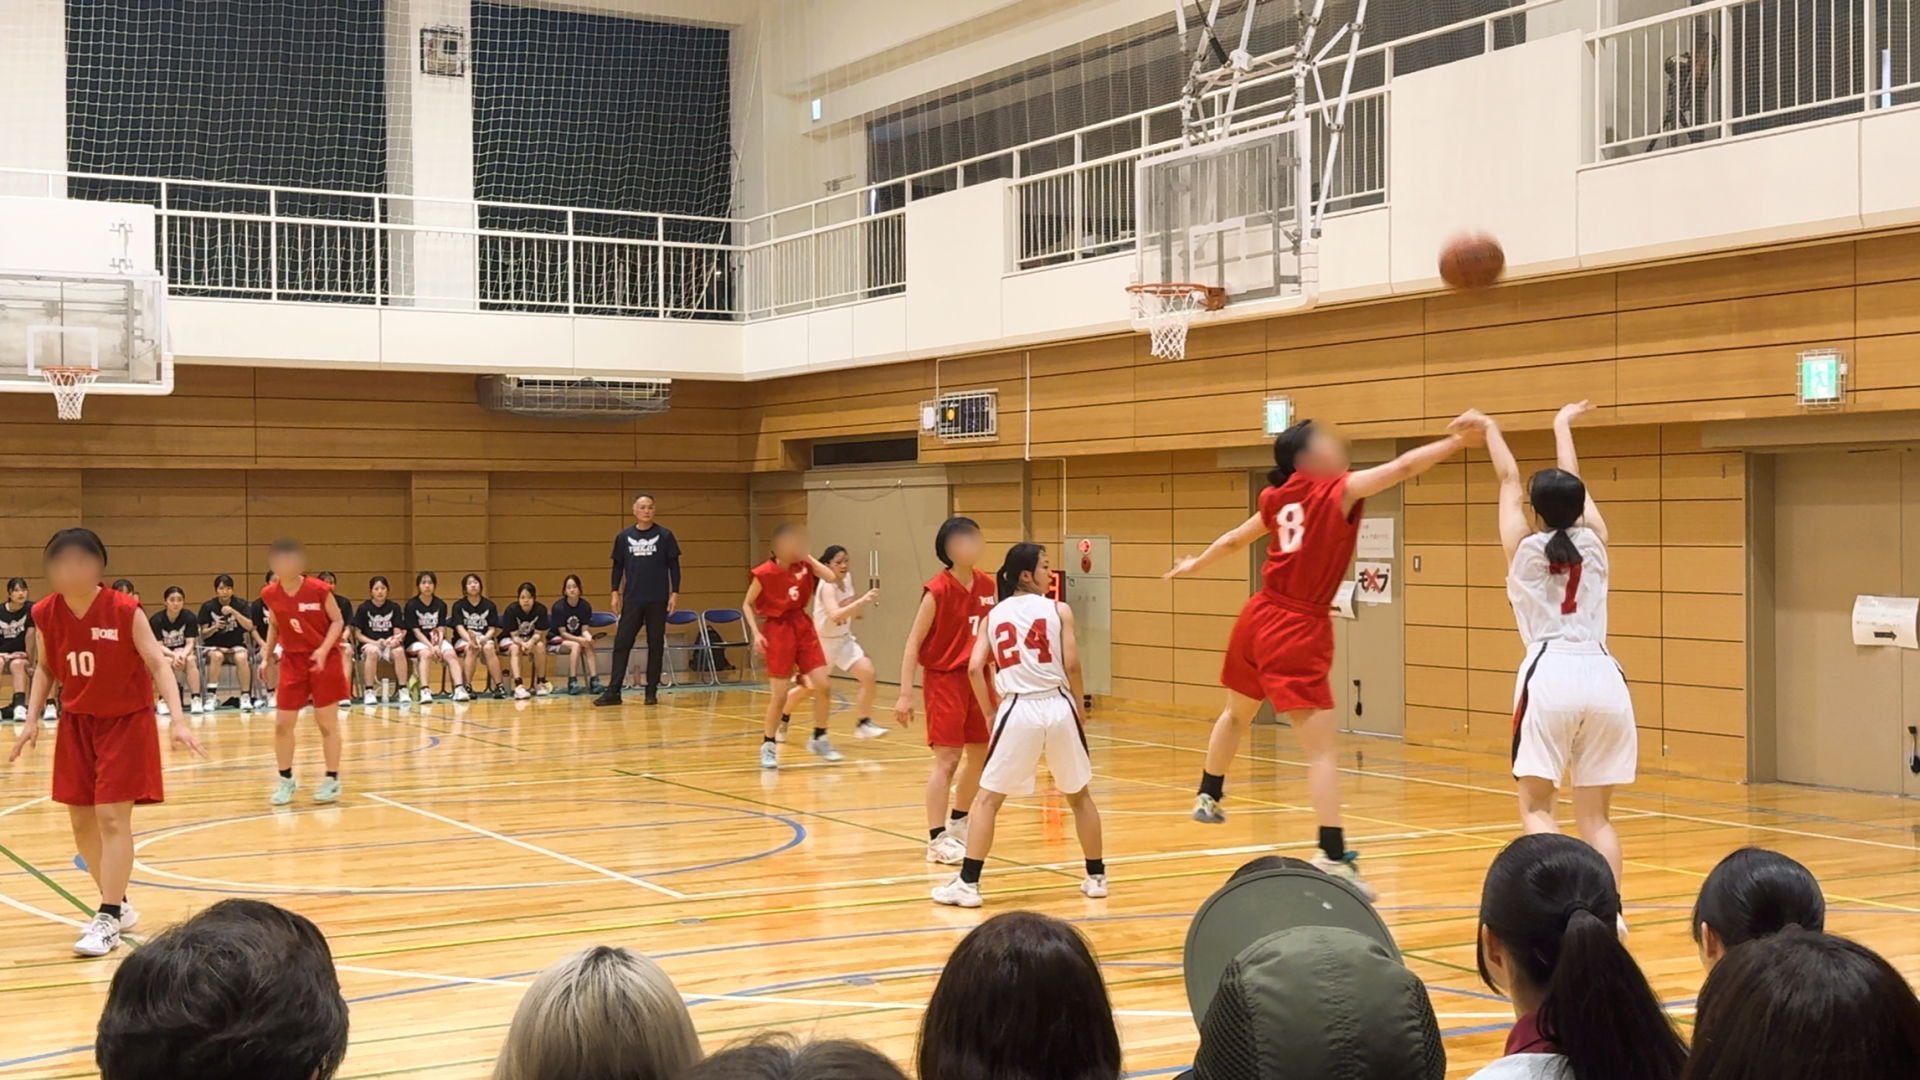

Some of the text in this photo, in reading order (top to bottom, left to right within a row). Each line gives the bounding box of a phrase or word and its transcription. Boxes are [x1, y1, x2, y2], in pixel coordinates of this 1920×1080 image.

[1276, 502, 1305, 553] 8
[788, 585, 800, 601] 6
[1549, 561, 1582, 615] 7
[289, 618, 303, 634] 9
[968, 615, 980, 636] 7
[995, 618, 1052, 670] 24
[66, 651, 95, 677] 10
